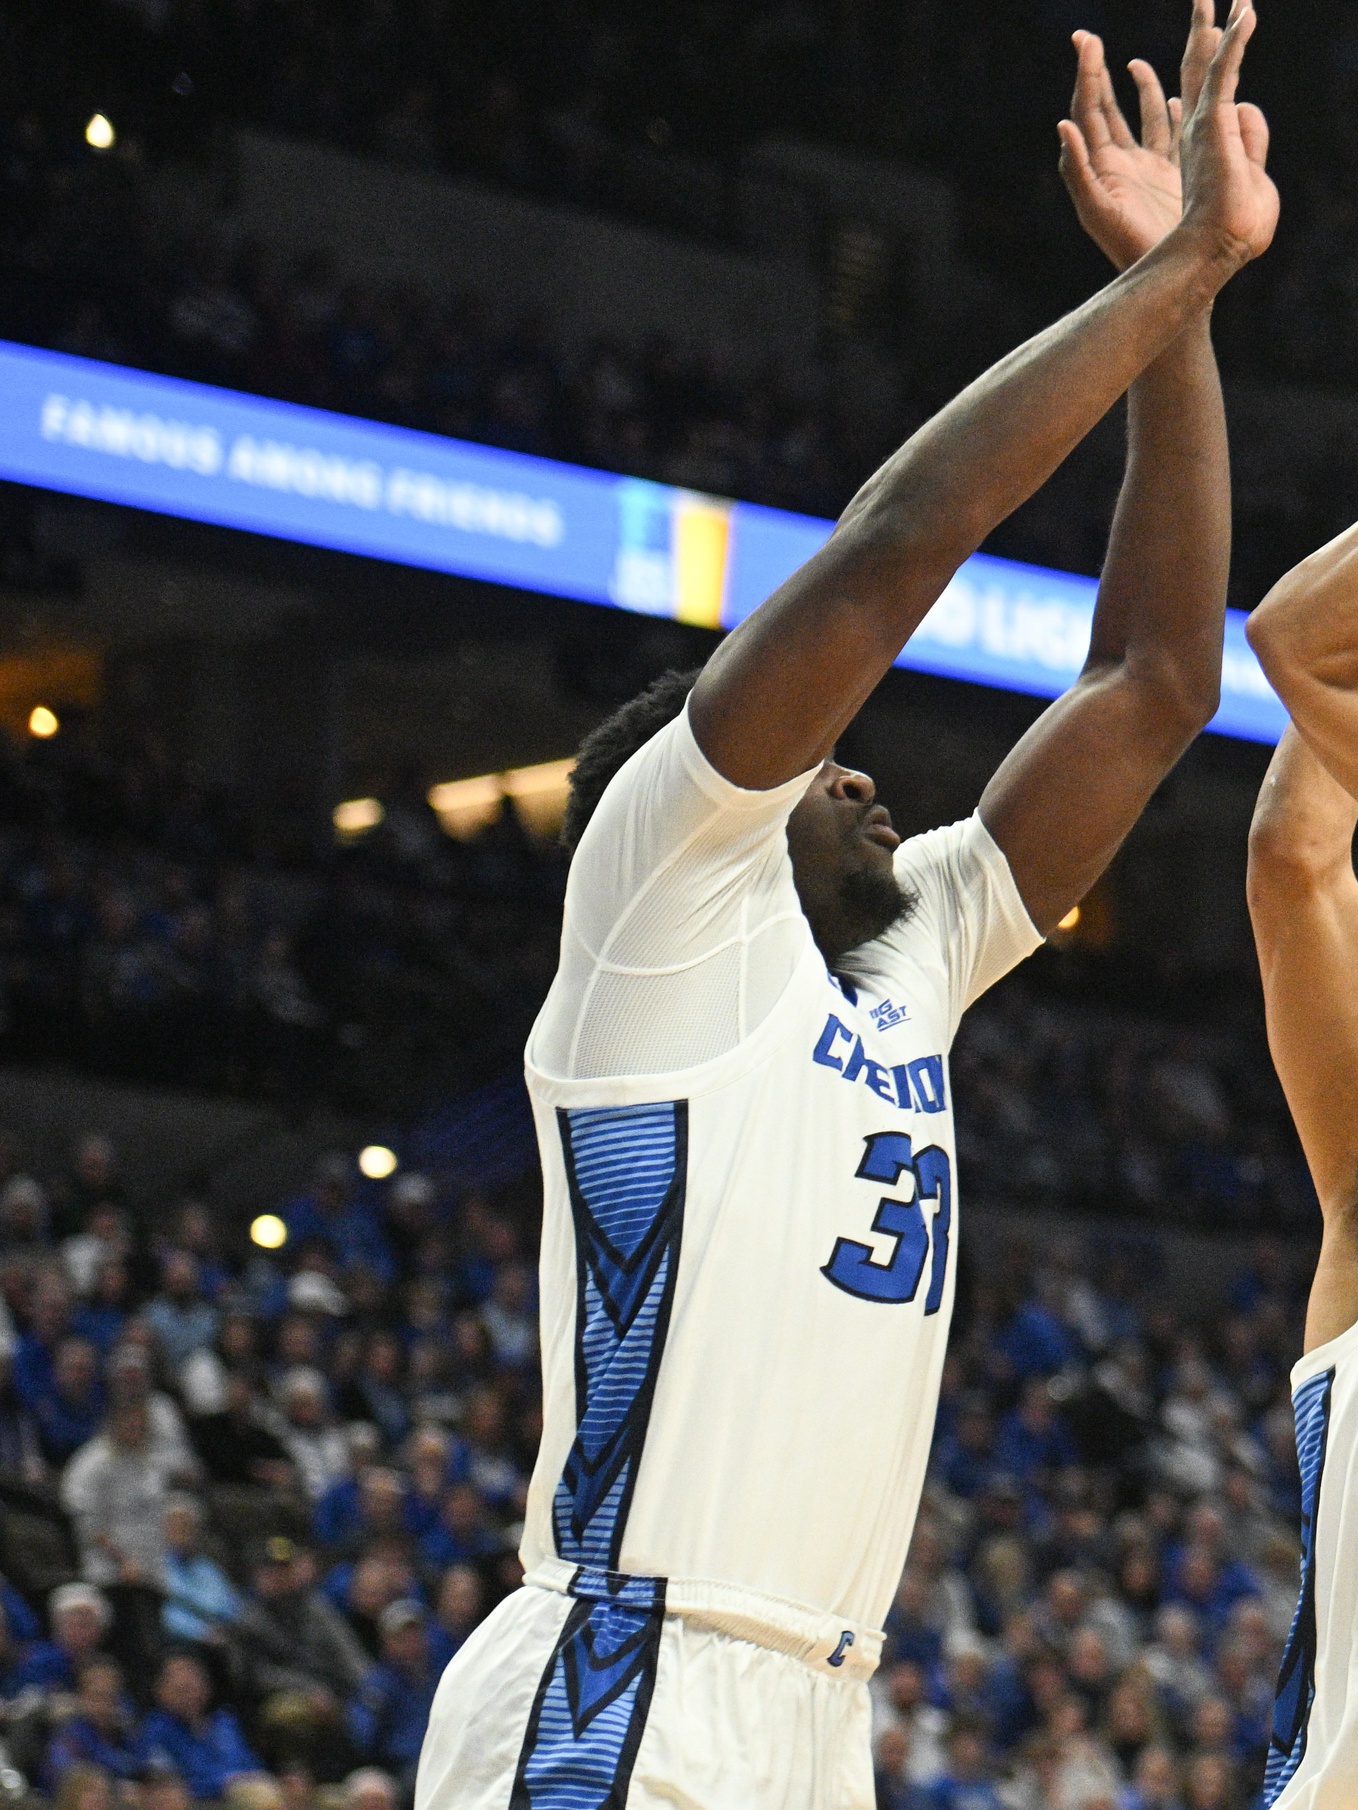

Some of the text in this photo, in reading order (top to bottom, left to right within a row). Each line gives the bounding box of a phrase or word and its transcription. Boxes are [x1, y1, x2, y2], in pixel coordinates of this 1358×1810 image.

[39, 392, 566, 549] FAMOUS AMONG FRIENDS
